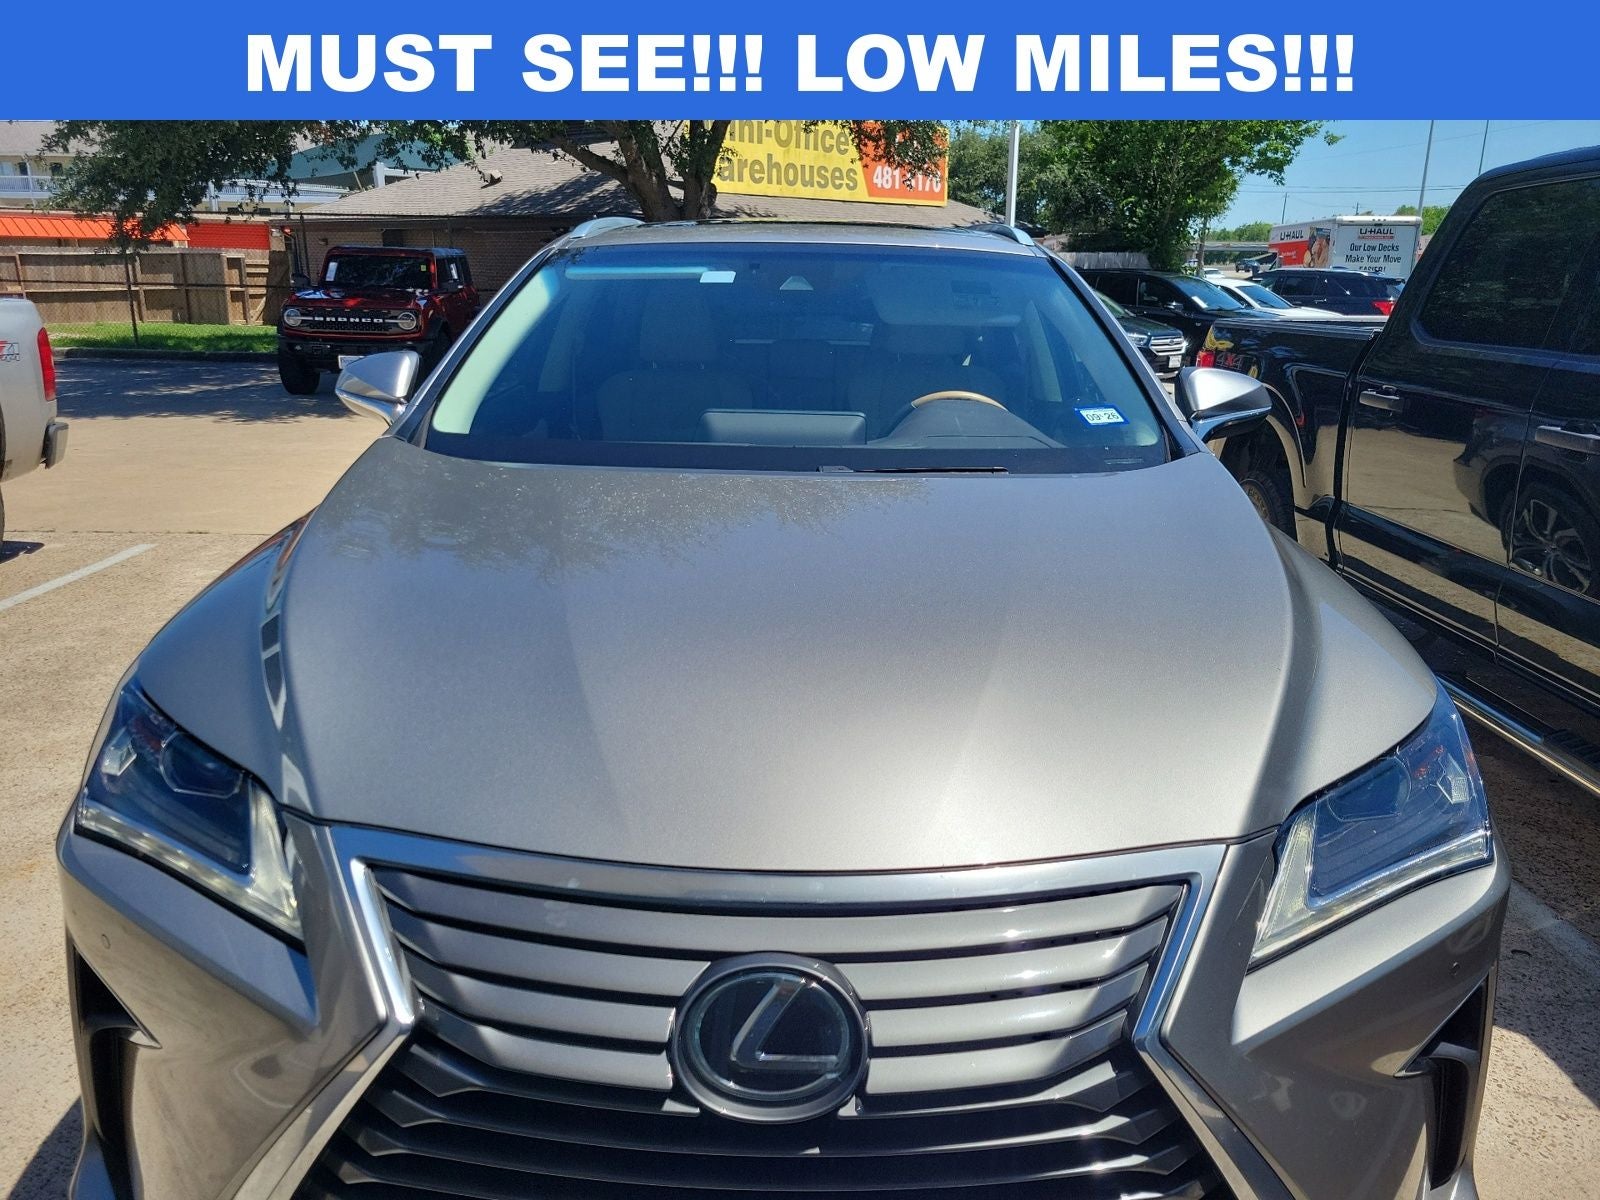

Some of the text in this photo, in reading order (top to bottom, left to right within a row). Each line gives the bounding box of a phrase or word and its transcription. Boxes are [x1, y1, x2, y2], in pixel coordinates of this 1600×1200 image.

[724, 120, 850, 155] ini-Office
[718, 153, 859, 192] arehouses
[872, 165, 942, 193] 481170
[1280, 230, 1303, 240] U-HAUL
[1350, 243, 1400, 252] Our Low Decks
[1345, 254, 1402, 263] Make Your Move
